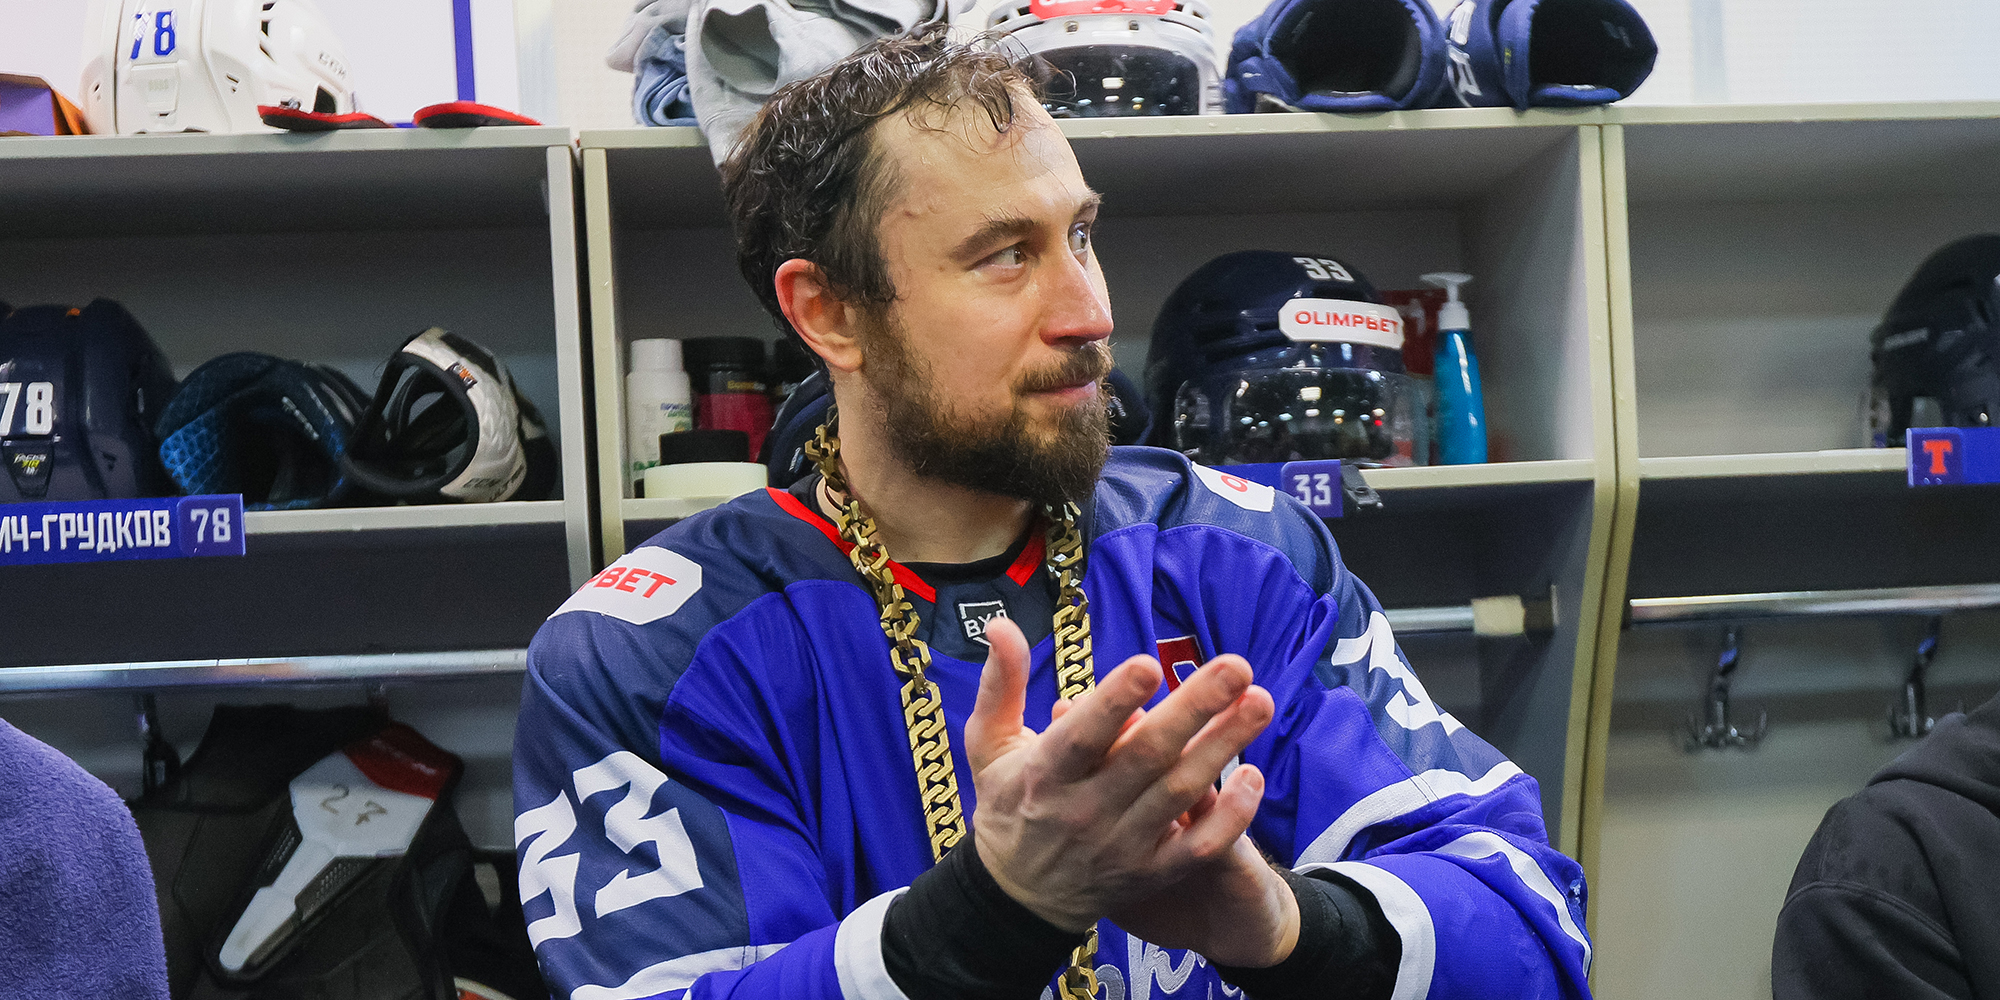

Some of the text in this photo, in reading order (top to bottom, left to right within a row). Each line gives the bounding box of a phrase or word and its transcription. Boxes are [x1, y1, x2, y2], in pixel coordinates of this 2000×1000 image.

[130, 10, 177, 60] 78
[1293, 257, 1354, 281] 33
[1295, 311, 1399, 334] OLIMPBET
[0, 382, 53, 436] 78
[1293, 473, 1332, 506] 33
[190, 507, 231, 543] 78
[514, 750, 704, 952] 33
